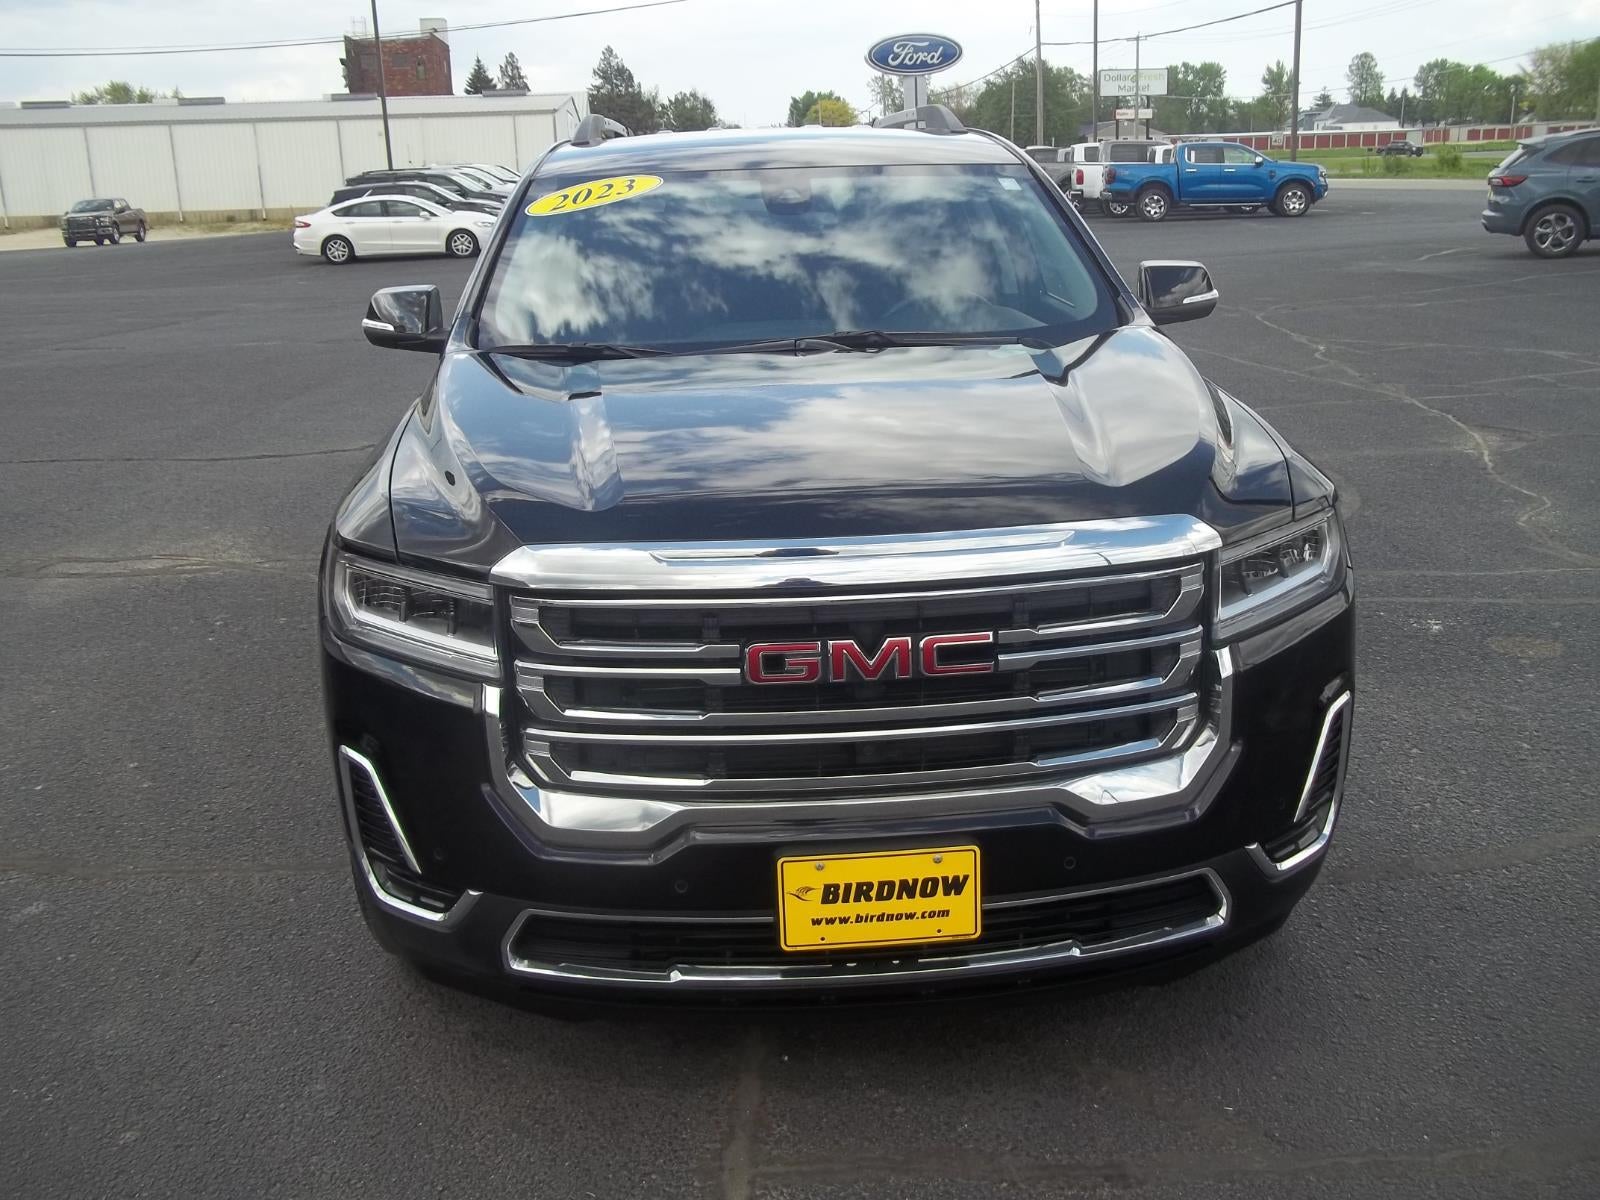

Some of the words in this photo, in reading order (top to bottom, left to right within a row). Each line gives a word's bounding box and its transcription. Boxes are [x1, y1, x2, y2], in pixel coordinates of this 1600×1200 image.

[887, 41, 943, 66] Ford
[549, 179, 636, 212] 2023
[744, 631, 995, 685] GMC
[820, 874, 970, 905] BIRDNOW
[811, 909, 950, 926] www.birdnow.com
